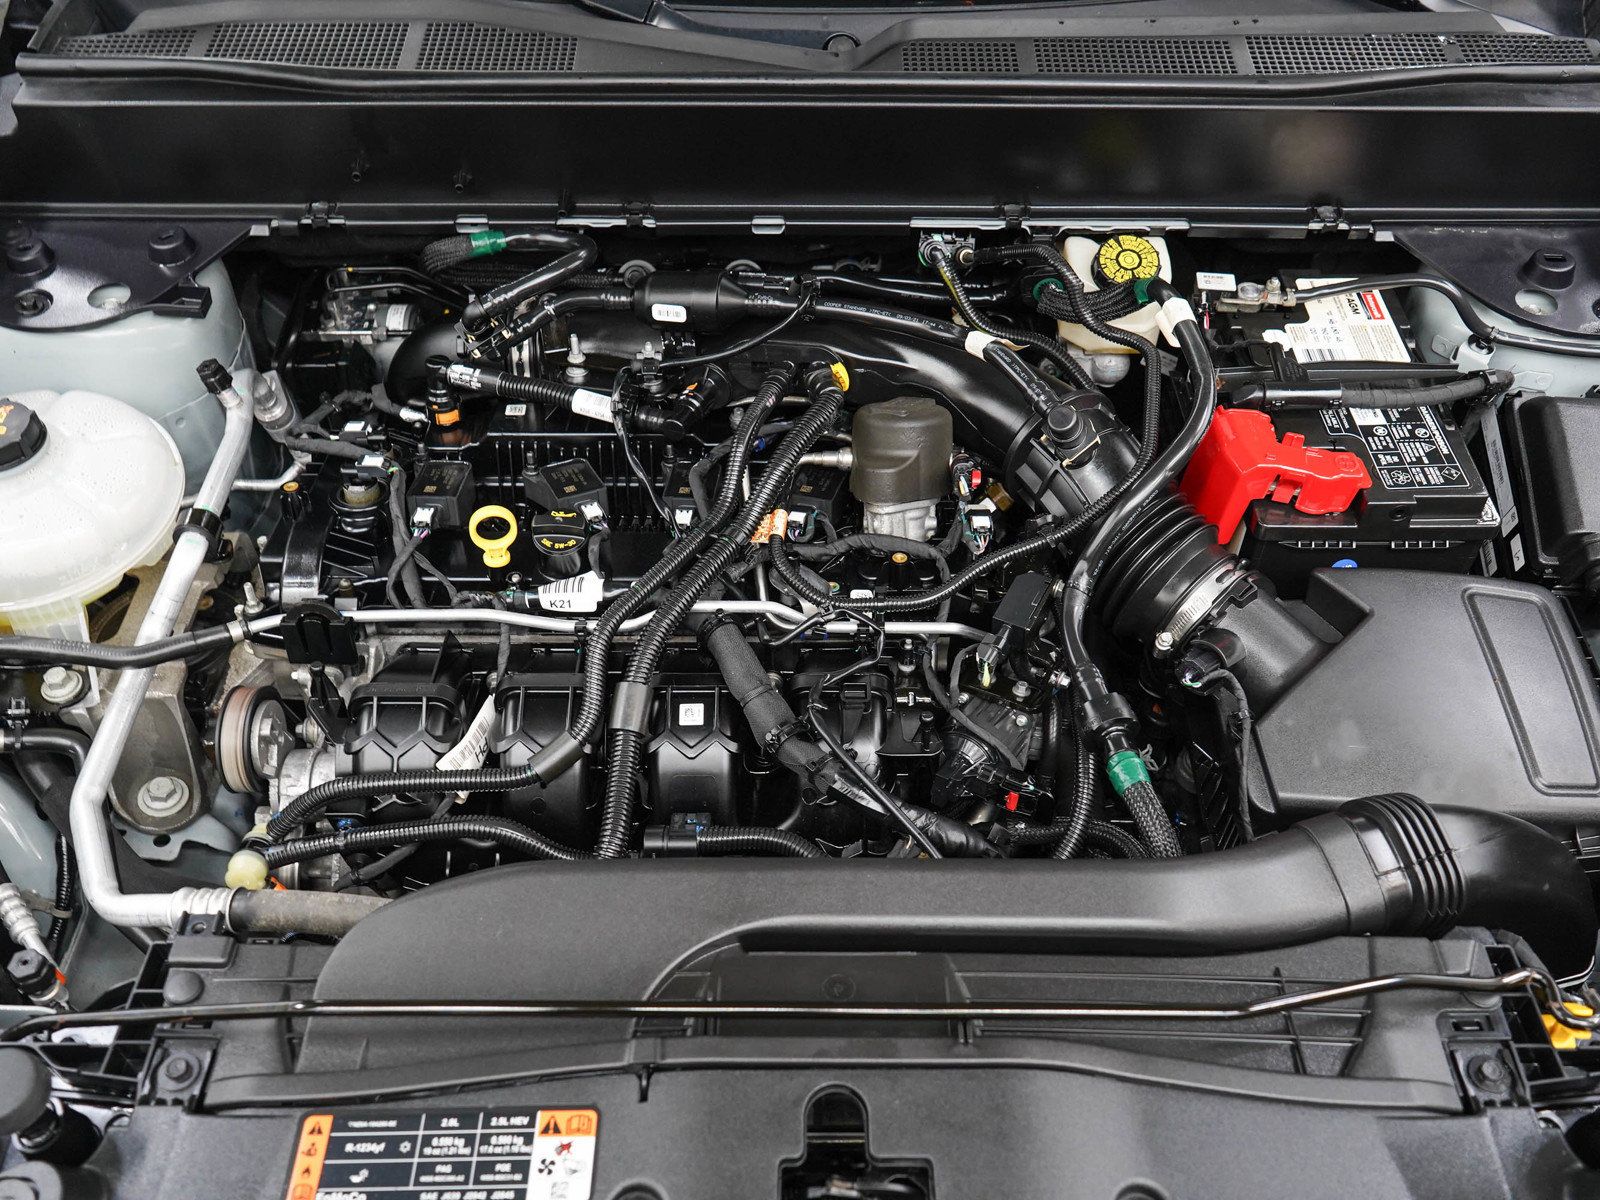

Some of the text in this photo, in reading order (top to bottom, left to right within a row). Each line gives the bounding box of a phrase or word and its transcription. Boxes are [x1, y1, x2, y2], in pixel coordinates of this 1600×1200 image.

[1347, 298, 1360, 314] AGM
[1418, 406, 1450, 454] DANGER/POISON
[554, 539, 576, 549] 5W-30
[549, 600, 571, 608] K21
[510, 1116, 529, 1126] HEV
[344, 1142, 386, 1154] R-1234yf
